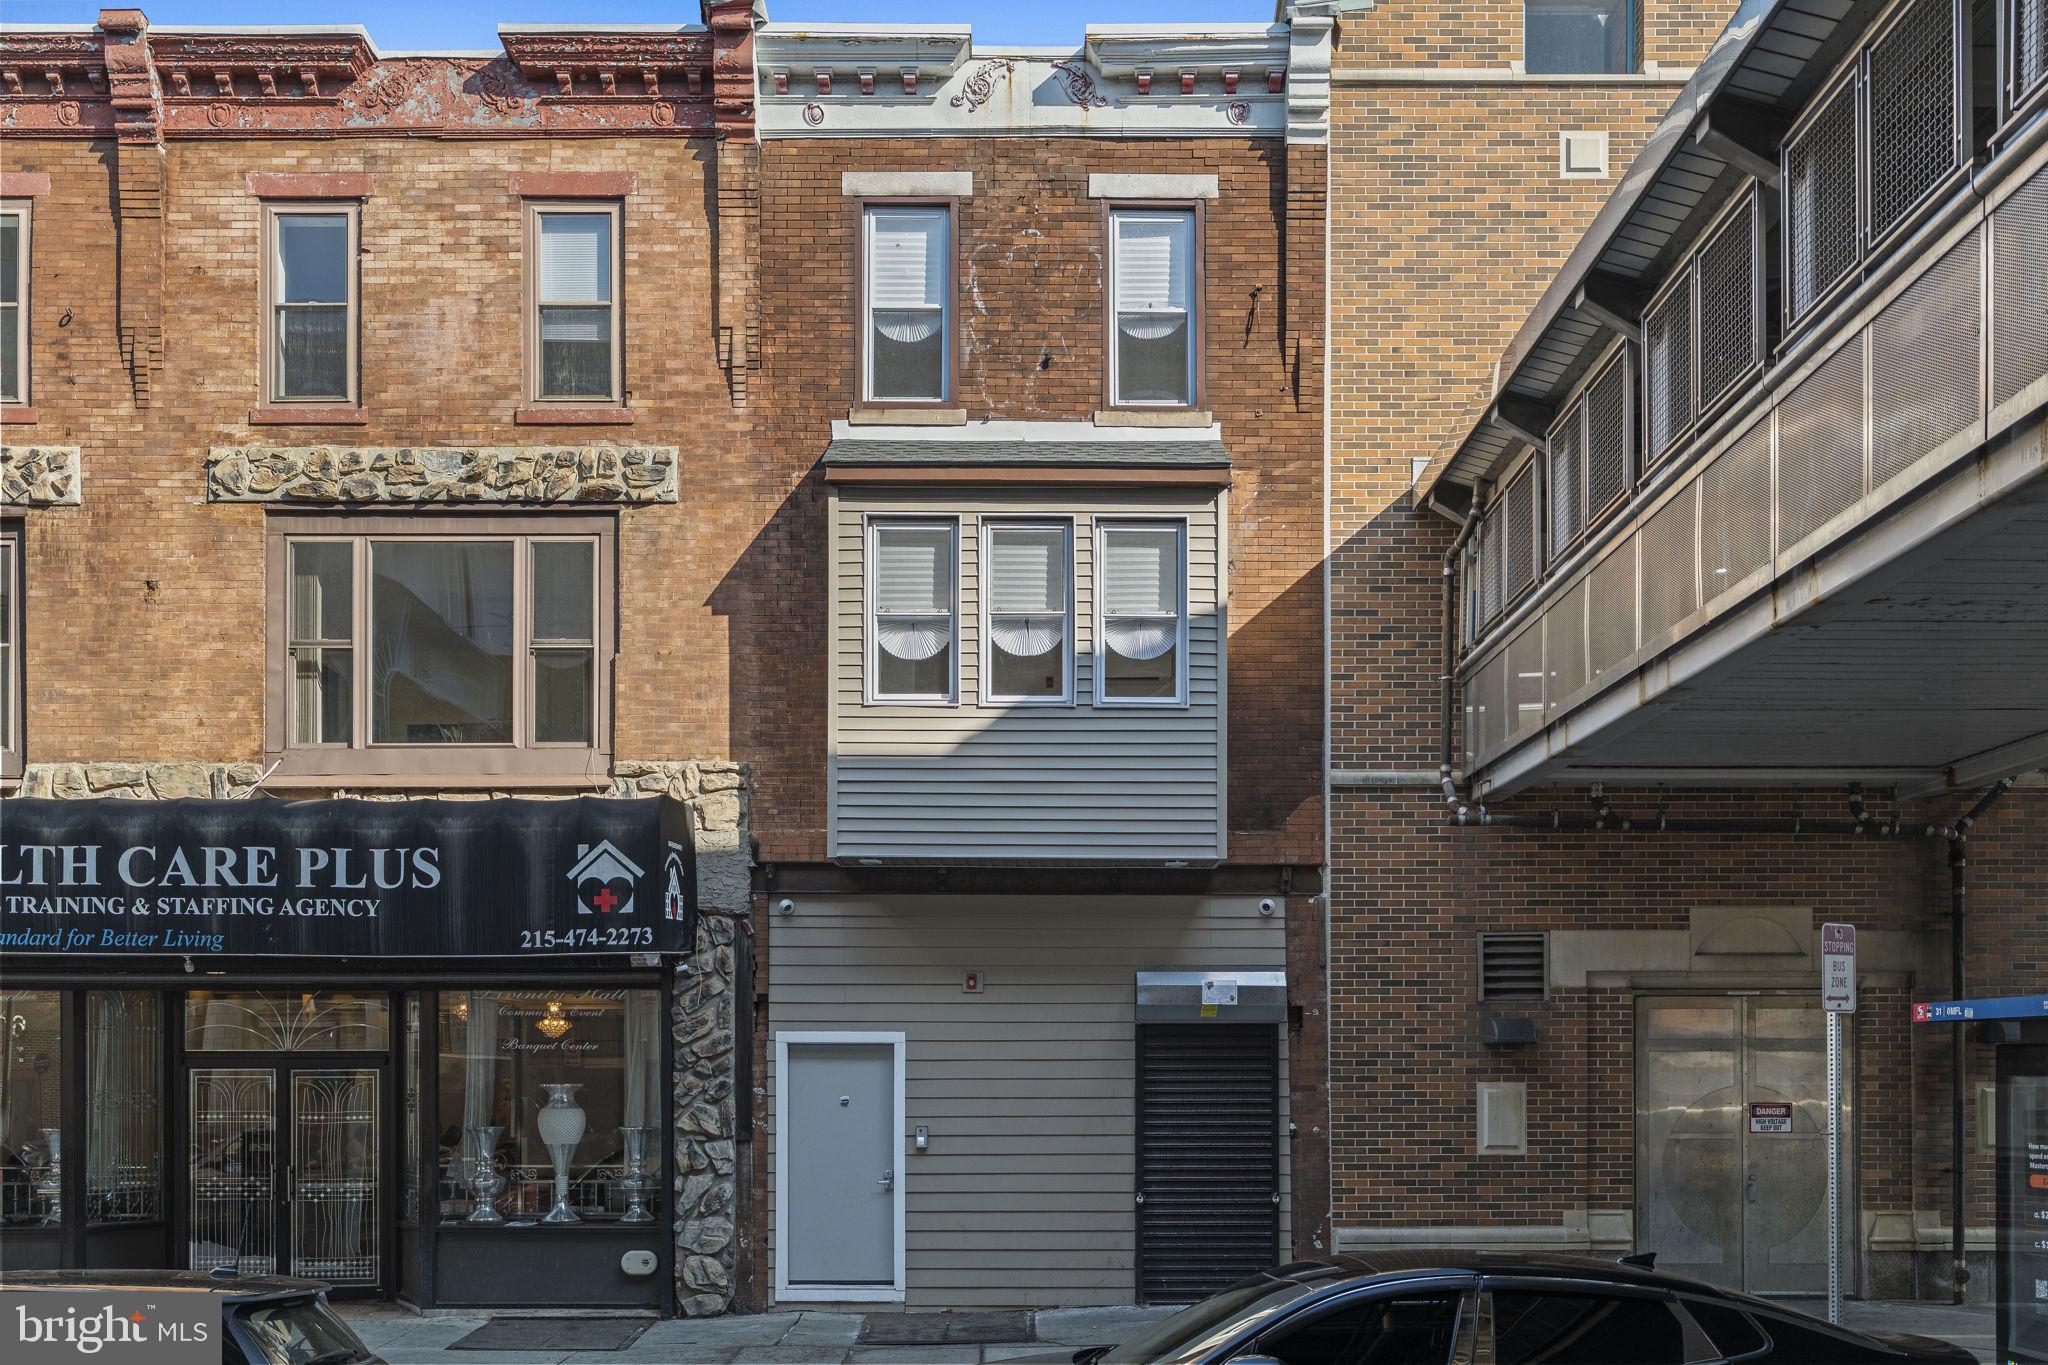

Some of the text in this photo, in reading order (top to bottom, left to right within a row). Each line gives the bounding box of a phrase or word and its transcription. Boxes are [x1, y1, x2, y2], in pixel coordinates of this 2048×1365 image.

[0, 845, 441, 889] LTH CARE PLUS
[6, 896, 381, 917] TRAINING & STAFFING AGENCY
[63, 928, 94, 950] for
[99, 929, 157, 947] Better
[162, 929, 224, 951] Living
[520, 926, 653, 948] 215-474-2273
[1834, 928, 1844, 940] NO
[1824, 941, 1854, 953] STOPPING
[1832, 961, 1846, 972] BUS
[1832, 976, 1847, 988] ZONE
[499, 1004, 605, 1018] Communy Event
[1935, 1007, 1943, 1016] 31
[502, 1037, 600, 1053] Banquet Center
